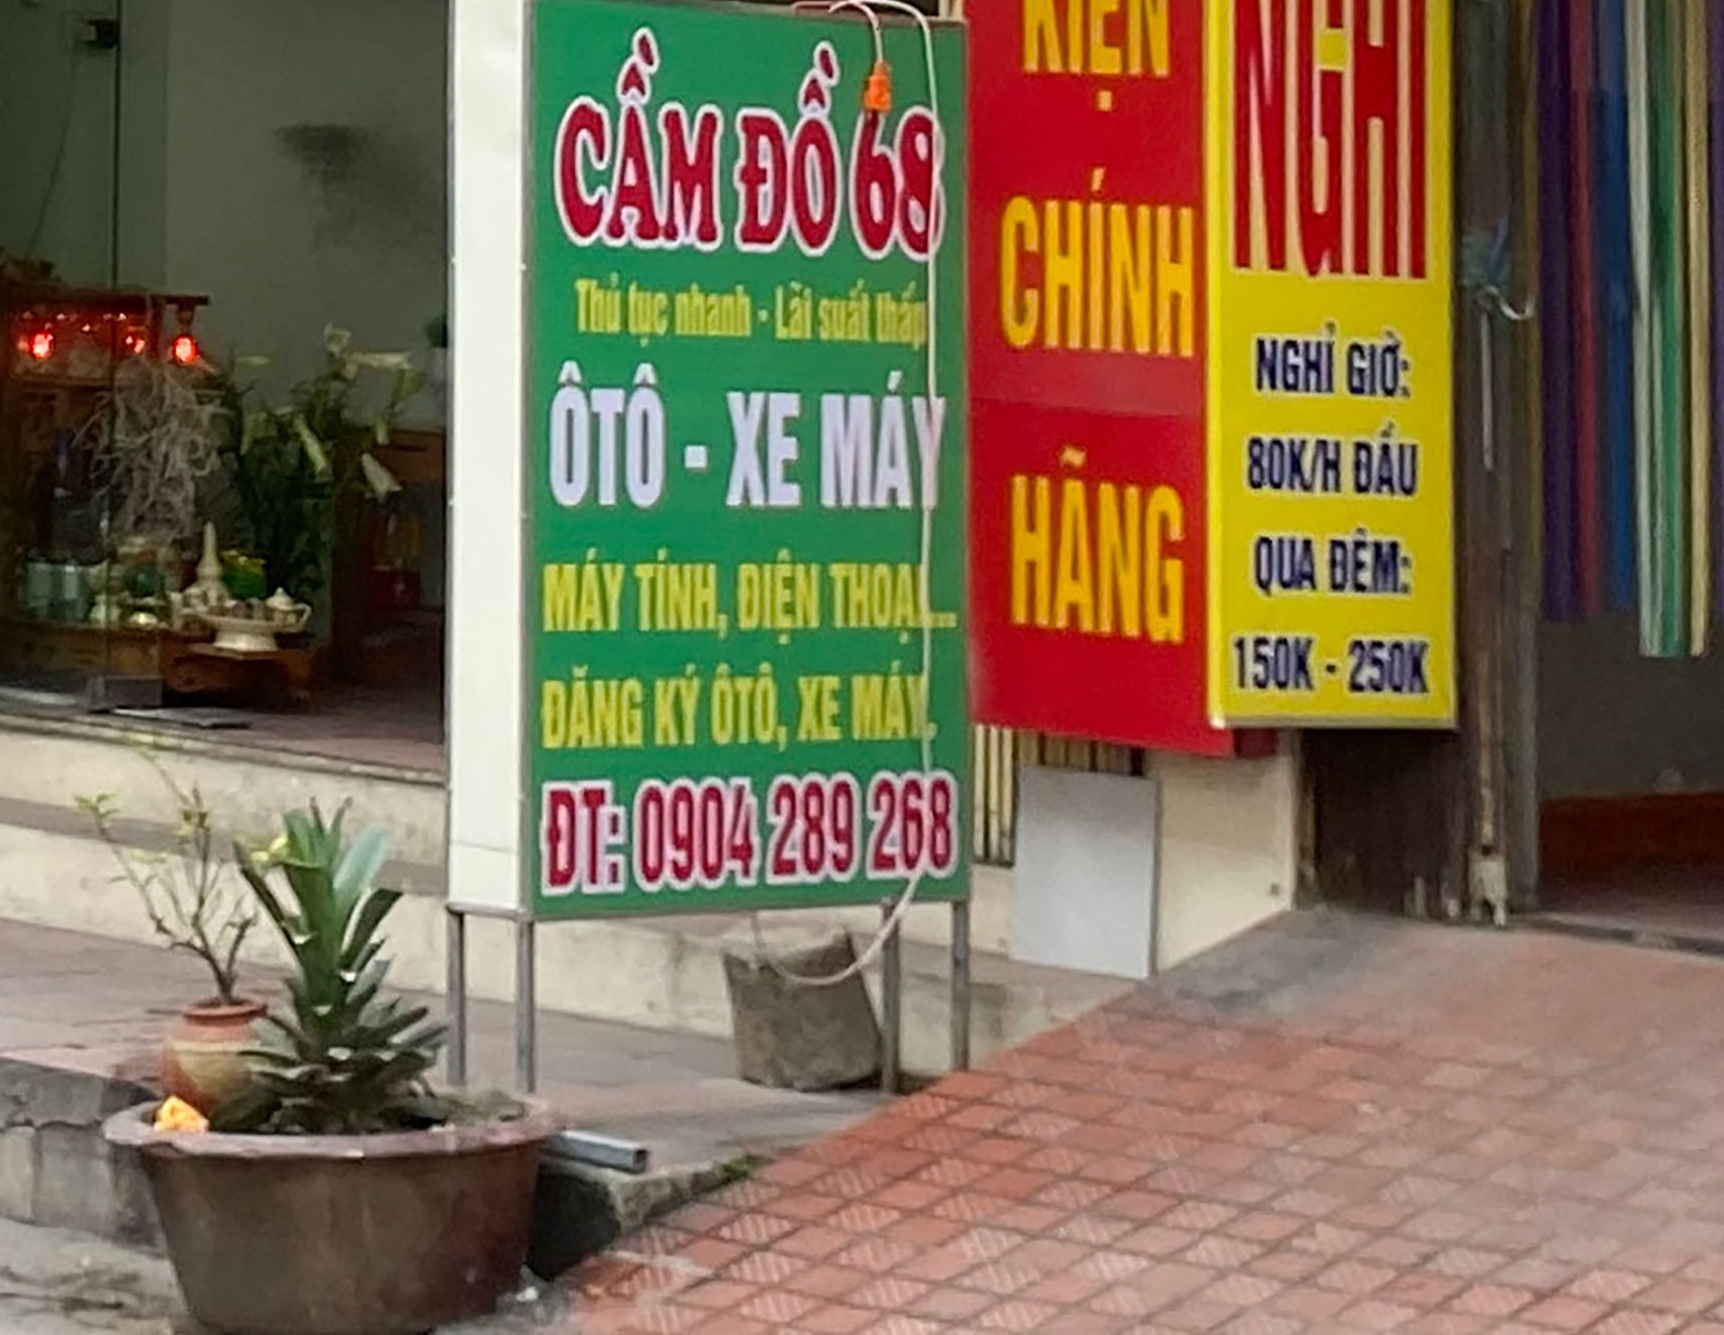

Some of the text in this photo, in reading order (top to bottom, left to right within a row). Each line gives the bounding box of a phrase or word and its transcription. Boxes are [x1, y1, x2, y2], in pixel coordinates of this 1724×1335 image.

[556, 27, 944, 261] CẦM ĐỒ 68
[575, 272, 620, 334] Thủ
[628, 280, 668, 347] tục
[674, 283, 751, 337] nhanh
[774, 281, 812, 341] Lãi
[819, 278, 870, 341] suất
[1001, 167, 1194, 359] CHÍNH
[1254, 321, 1336, 396] NGHỈ
[550, 361, 945, 508] ÔTÔ XE MÁY
[1011, 445, 1184, 643] HÃNG
[1253, 535, 1318, 597] QUA
[542, 549, 625, 632] MÁY
[737, 549, 820, 645] ĐIỆN
[541, 665, 644, 749] ĐĂNG
[654, 662, 701, 746] KÝ
[798, 675, 842, 741] XE
[1233, 636, 1429, 695] 150K 250K
[540, 770, 957, 895] ĐT: 0904 289 268
